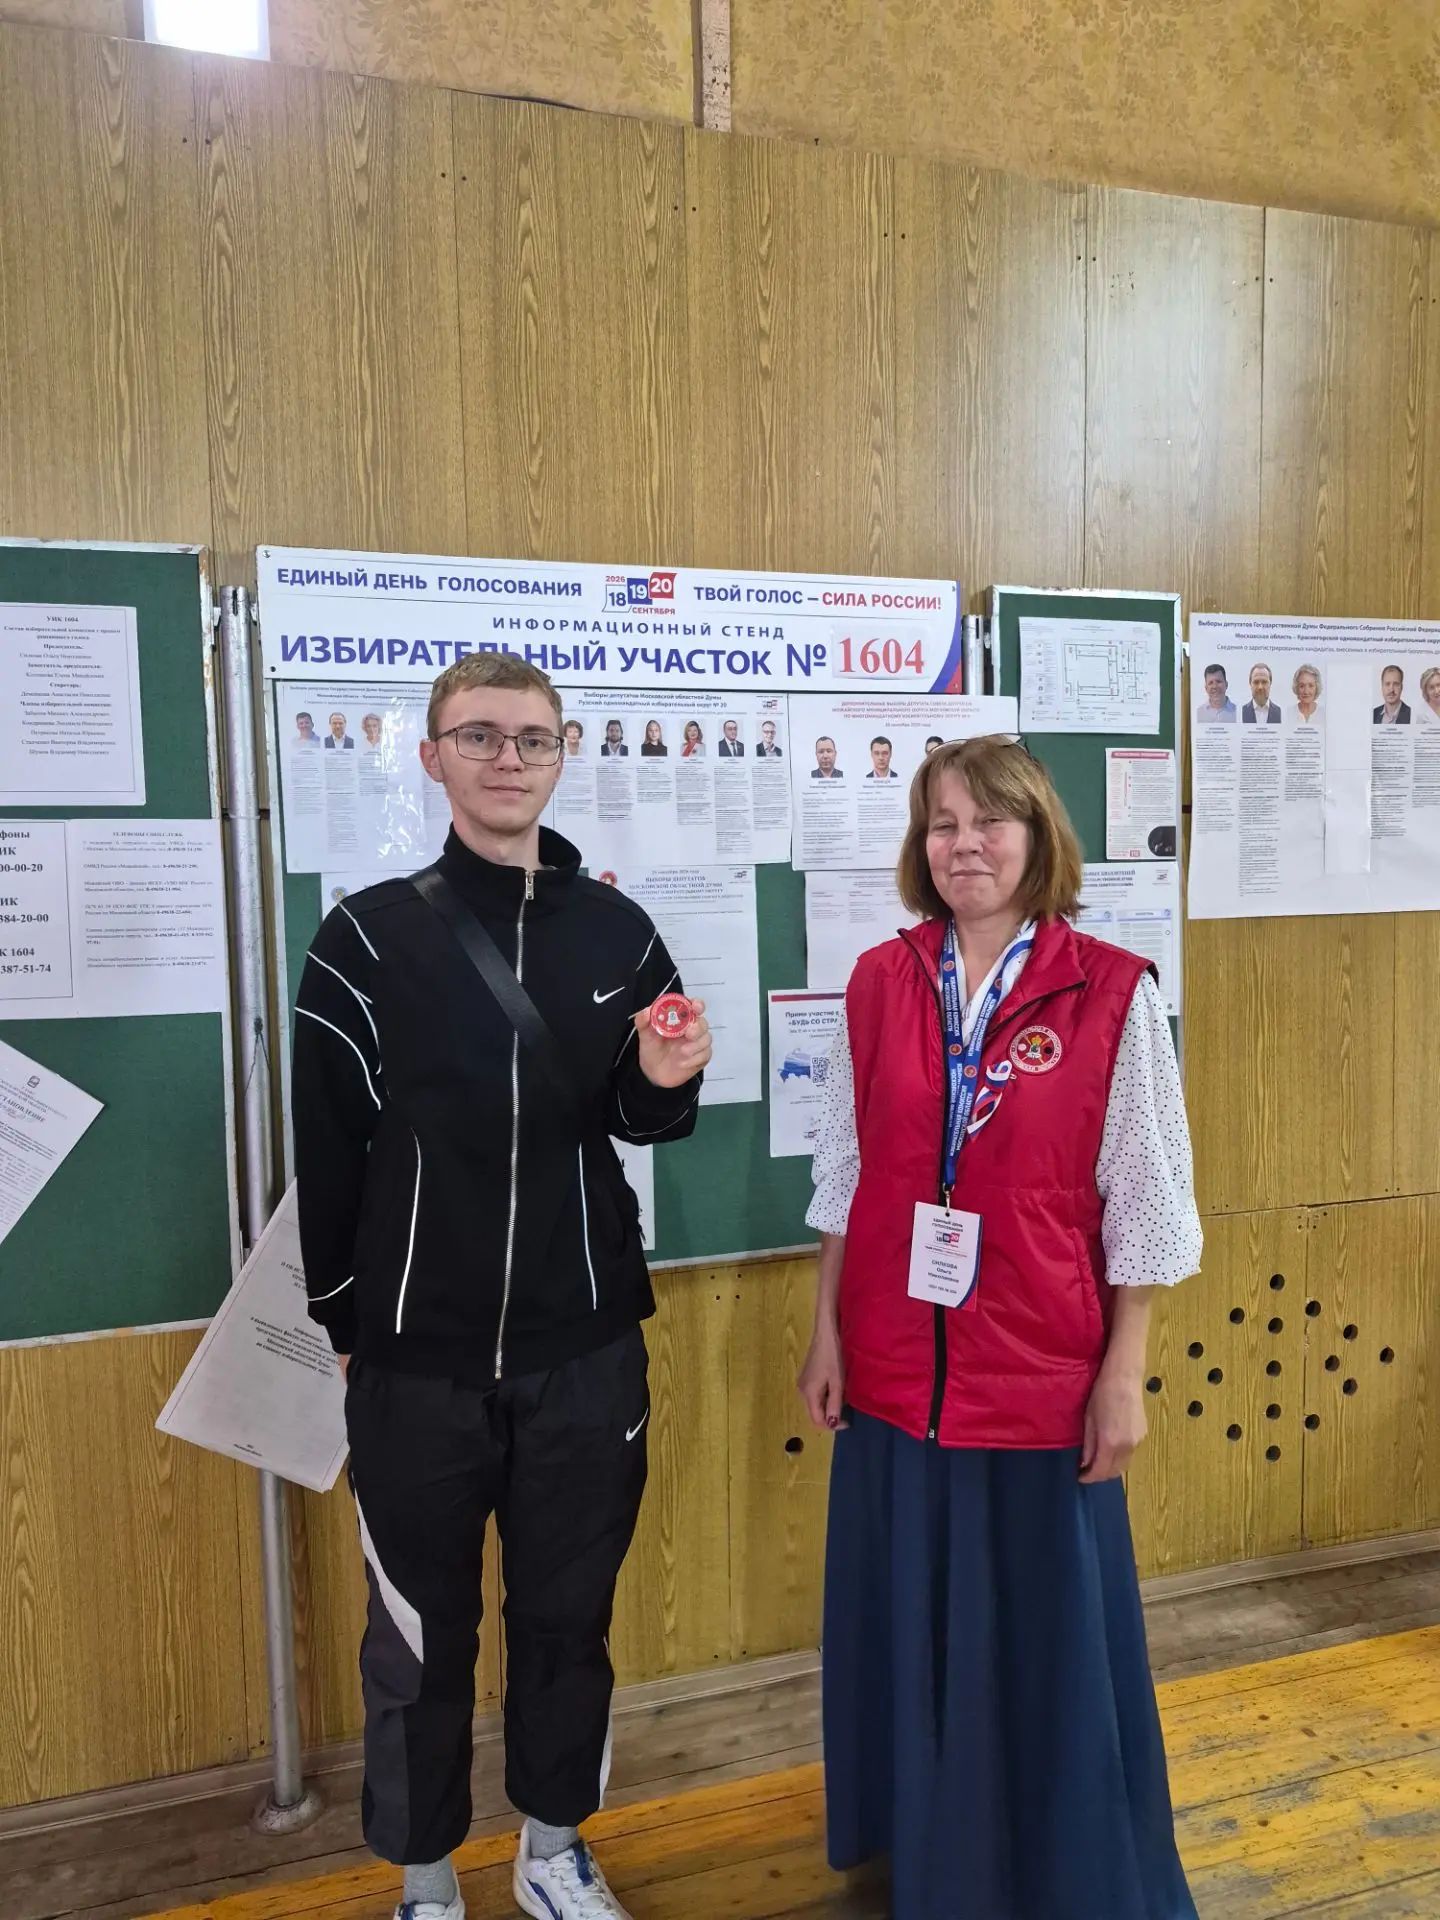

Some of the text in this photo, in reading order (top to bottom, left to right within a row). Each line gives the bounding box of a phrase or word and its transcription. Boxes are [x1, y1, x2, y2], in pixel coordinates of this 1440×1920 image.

[277, 567, 582, 597] ЕДИНЫЙ ДЕНЬ ГОЛОСОВАНИЯ
[608, 578, 672, 606] 18 19 20
[693, 583, 742, 602] ТВОЙ
[746, 588, 803, 604] ГОЛОС
[822, 591, 867, 607] СИЛА
[871, 594, 942, 610] РОССИИ!
[632, 606, 675, 615] СЕНТЯБРЯ
[493, 616, 784, 640] ИНФОРМАЦИОННЫЙ СТЕНД
[617, 647, 772, 676] УЧАСТОК
[787, 643, 827, 677] №
[839, 638, 925, 675] 1604
[11, 947, 35, 957] 1604
